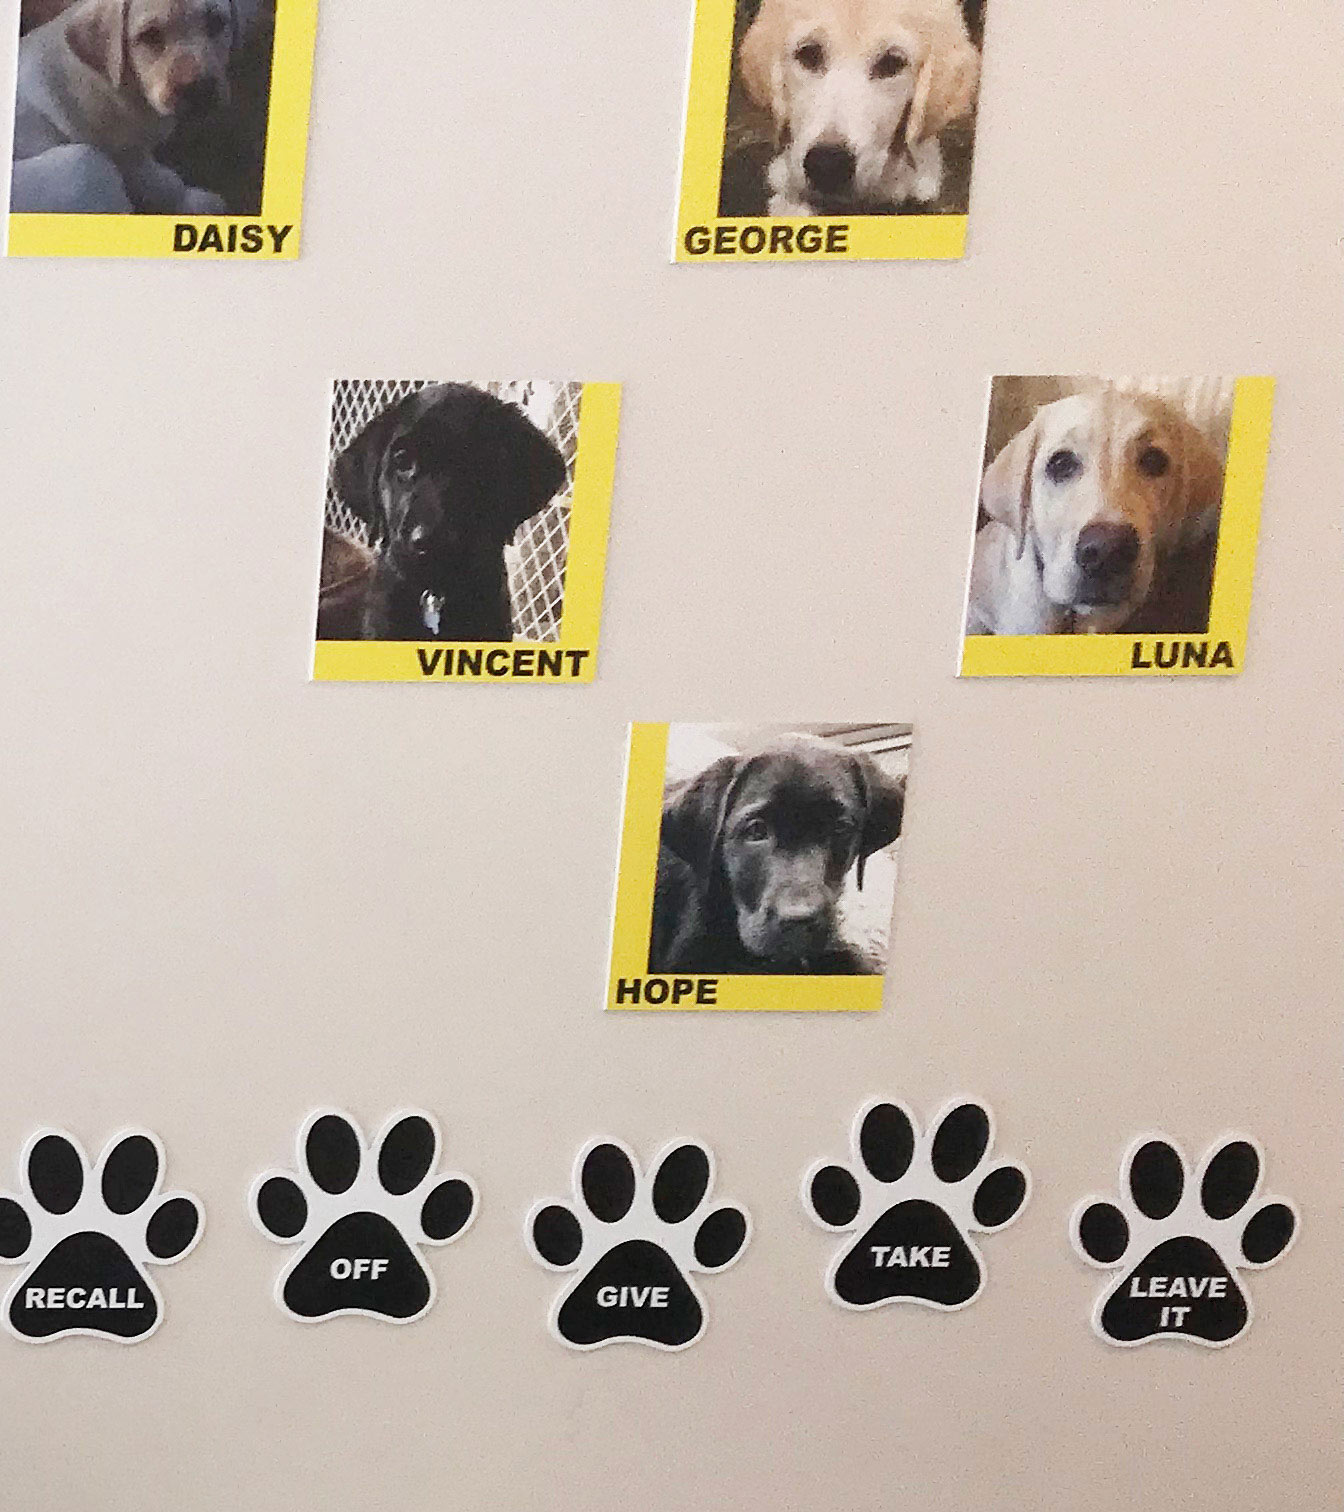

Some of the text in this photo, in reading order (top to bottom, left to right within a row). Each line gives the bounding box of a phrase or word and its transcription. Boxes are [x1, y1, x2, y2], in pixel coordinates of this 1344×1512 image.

[172, 223, 294, 254] DAISY
[684, 224, 849, 256] GEORGE
[416, 648, 590, 677] VINCENT
[1130, 640, 1235, 669] LUNA
[615, 978, 719, 1005] HOPE
[870, 1245, 952, 1268] TAKE
[330, 1258, 390, 1280] OFF
[25, 1287, 145, 1309] RECALL
[596, 1285, 670, 1308] GIVE
[1129, 1276, 1228, 1298] LEAVE
[1159, 1306, 1191, 1327] IT
